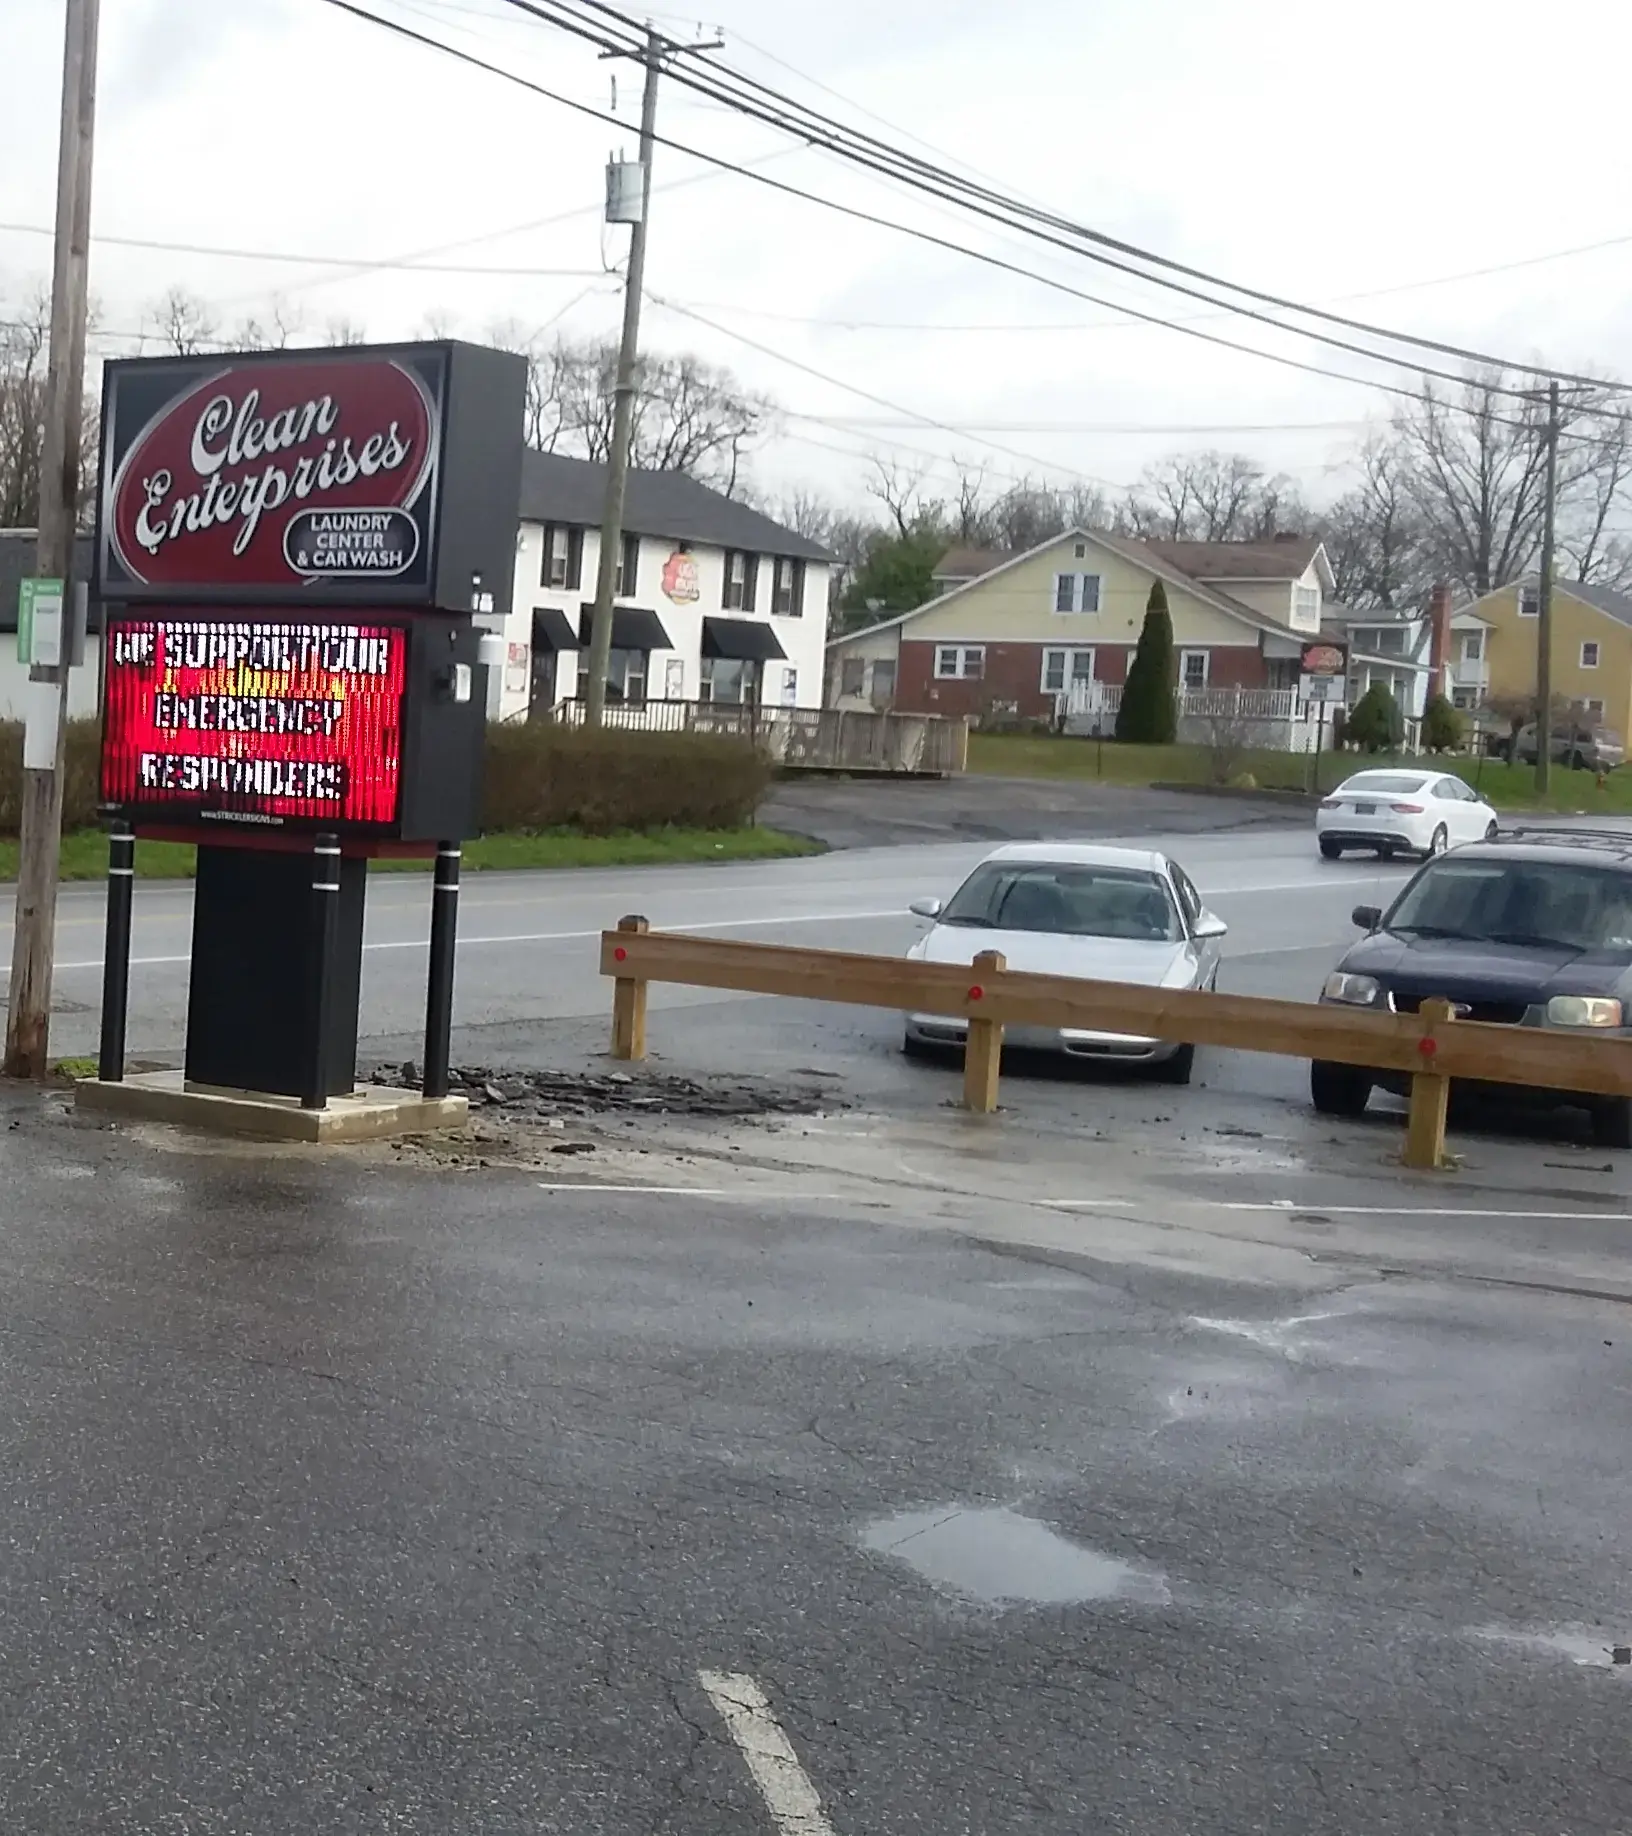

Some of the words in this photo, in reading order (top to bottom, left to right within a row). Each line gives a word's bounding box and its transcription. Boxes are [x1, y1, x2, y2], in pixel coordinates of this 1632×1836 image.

[190, 387, 339, 476] Clean
[134, 420, 412, 556] Enterprises
[310, 514, 393, 532] LAUNDRY
[316, 532, 384, 549] CENTER
[296, 549, 308, 567] &
[312, 550, 347, 567] CAR
[349, 549, 403, 567] WASH
[114, 631, 155, 666] WE
[164, 632, 314, 672] SUPPORT
[321, 636, 389, 675] OUR
[154, 694, 343, 736] EMERGENCY
[141, 752, 342, 800] RESPONDERS
